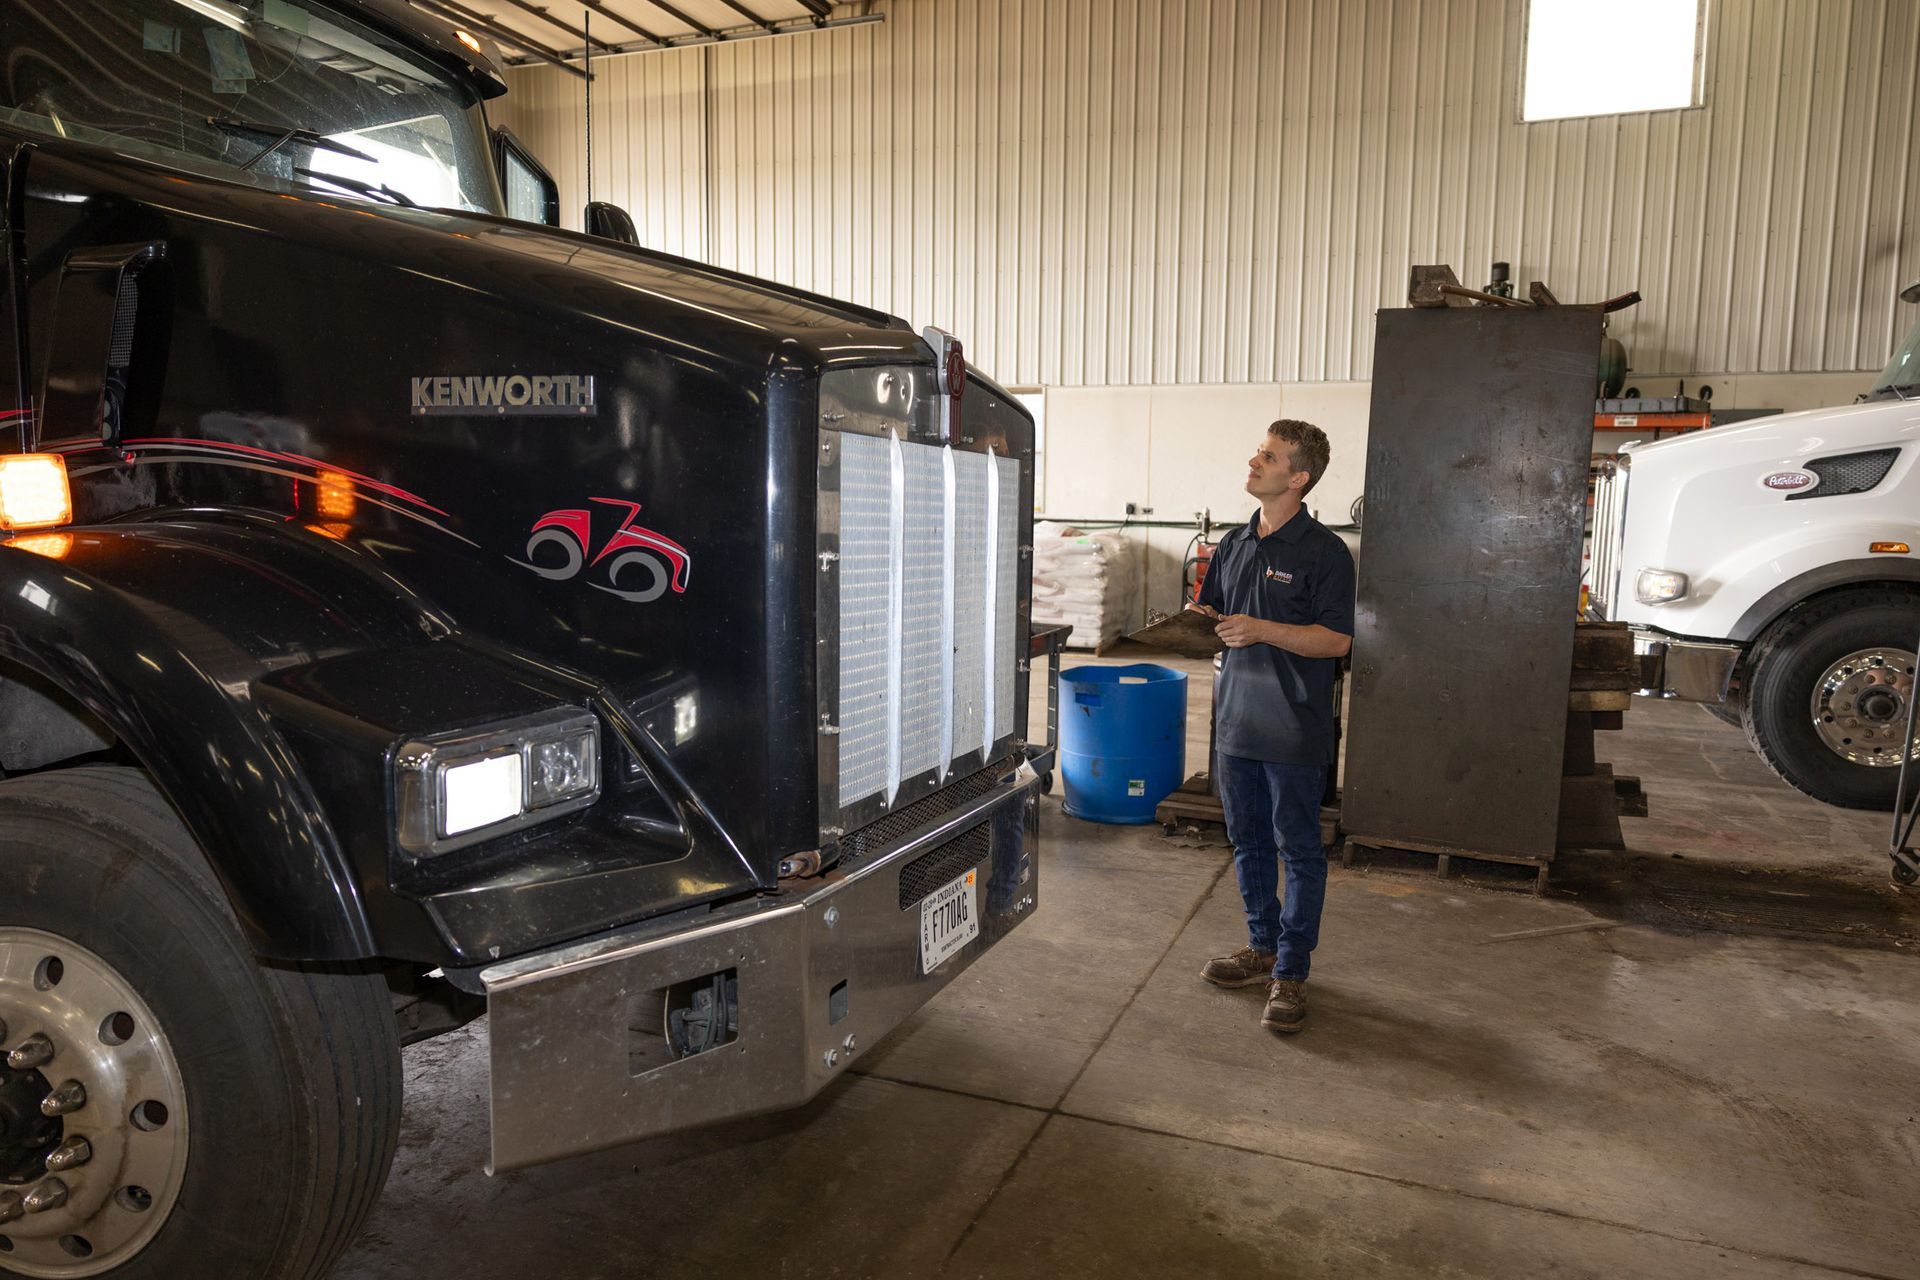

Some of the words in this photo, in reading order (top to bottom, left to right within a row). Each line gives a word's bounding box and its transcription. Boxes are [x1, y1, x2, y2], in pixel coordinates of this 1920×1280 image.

[411, 375, 594, 407] KENWORTH
[937, 881, 963, 904] INDIANA
[932, 891, 968, 943] F770AG
[969, 923, 976, 934] 91
